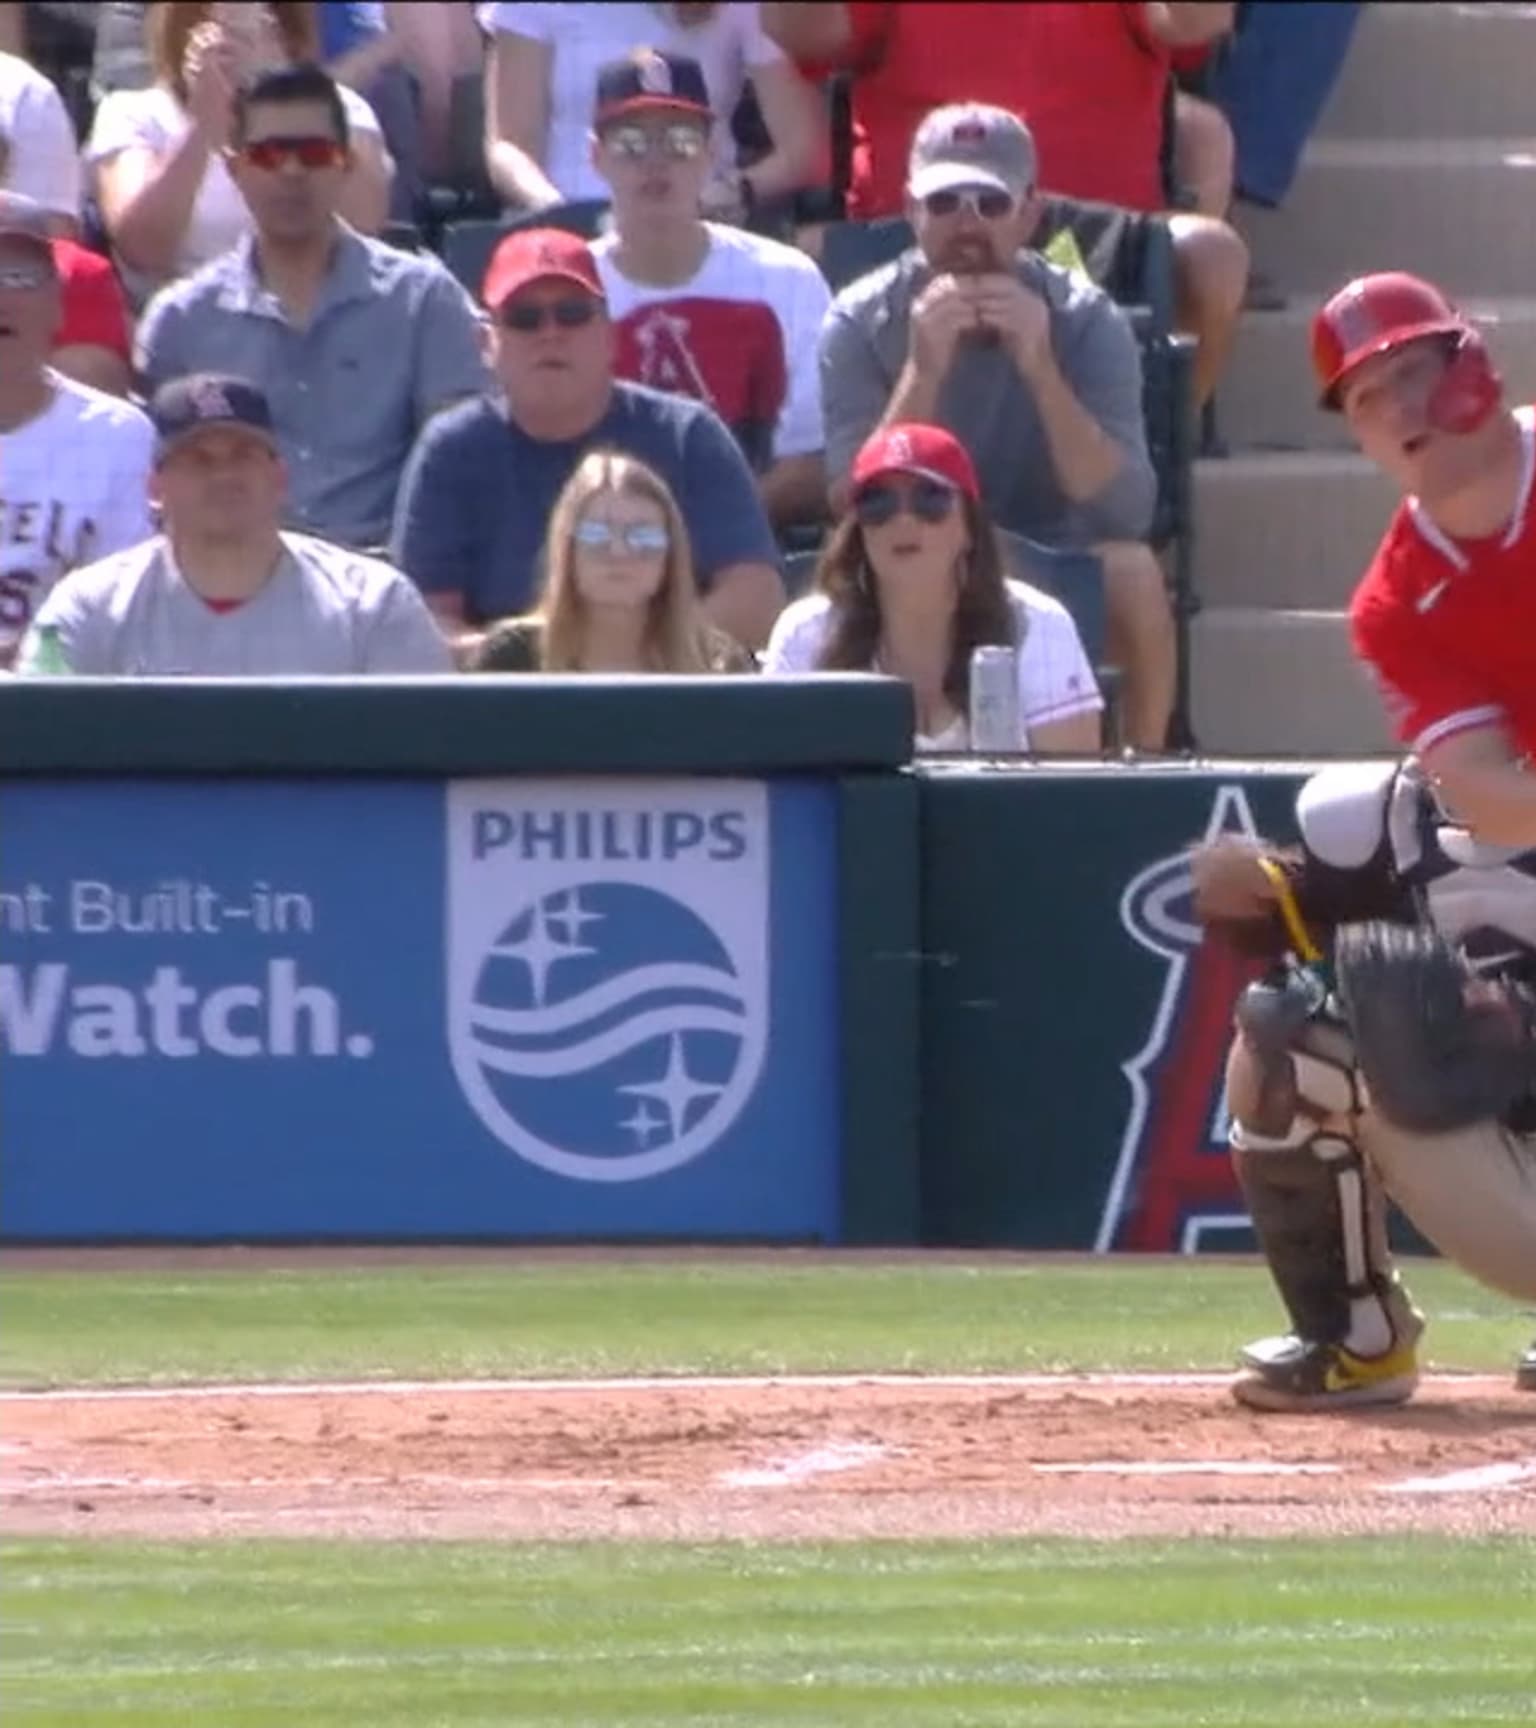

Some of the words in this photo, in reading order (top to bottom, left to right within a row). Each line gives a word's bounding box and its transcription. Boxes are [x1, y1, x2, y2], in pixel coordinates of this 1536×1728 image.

[470, 809, 749, 861] PHILIPS
[0, 881, 52, 933] nt
[71, 879, 314, 934] Built-in
